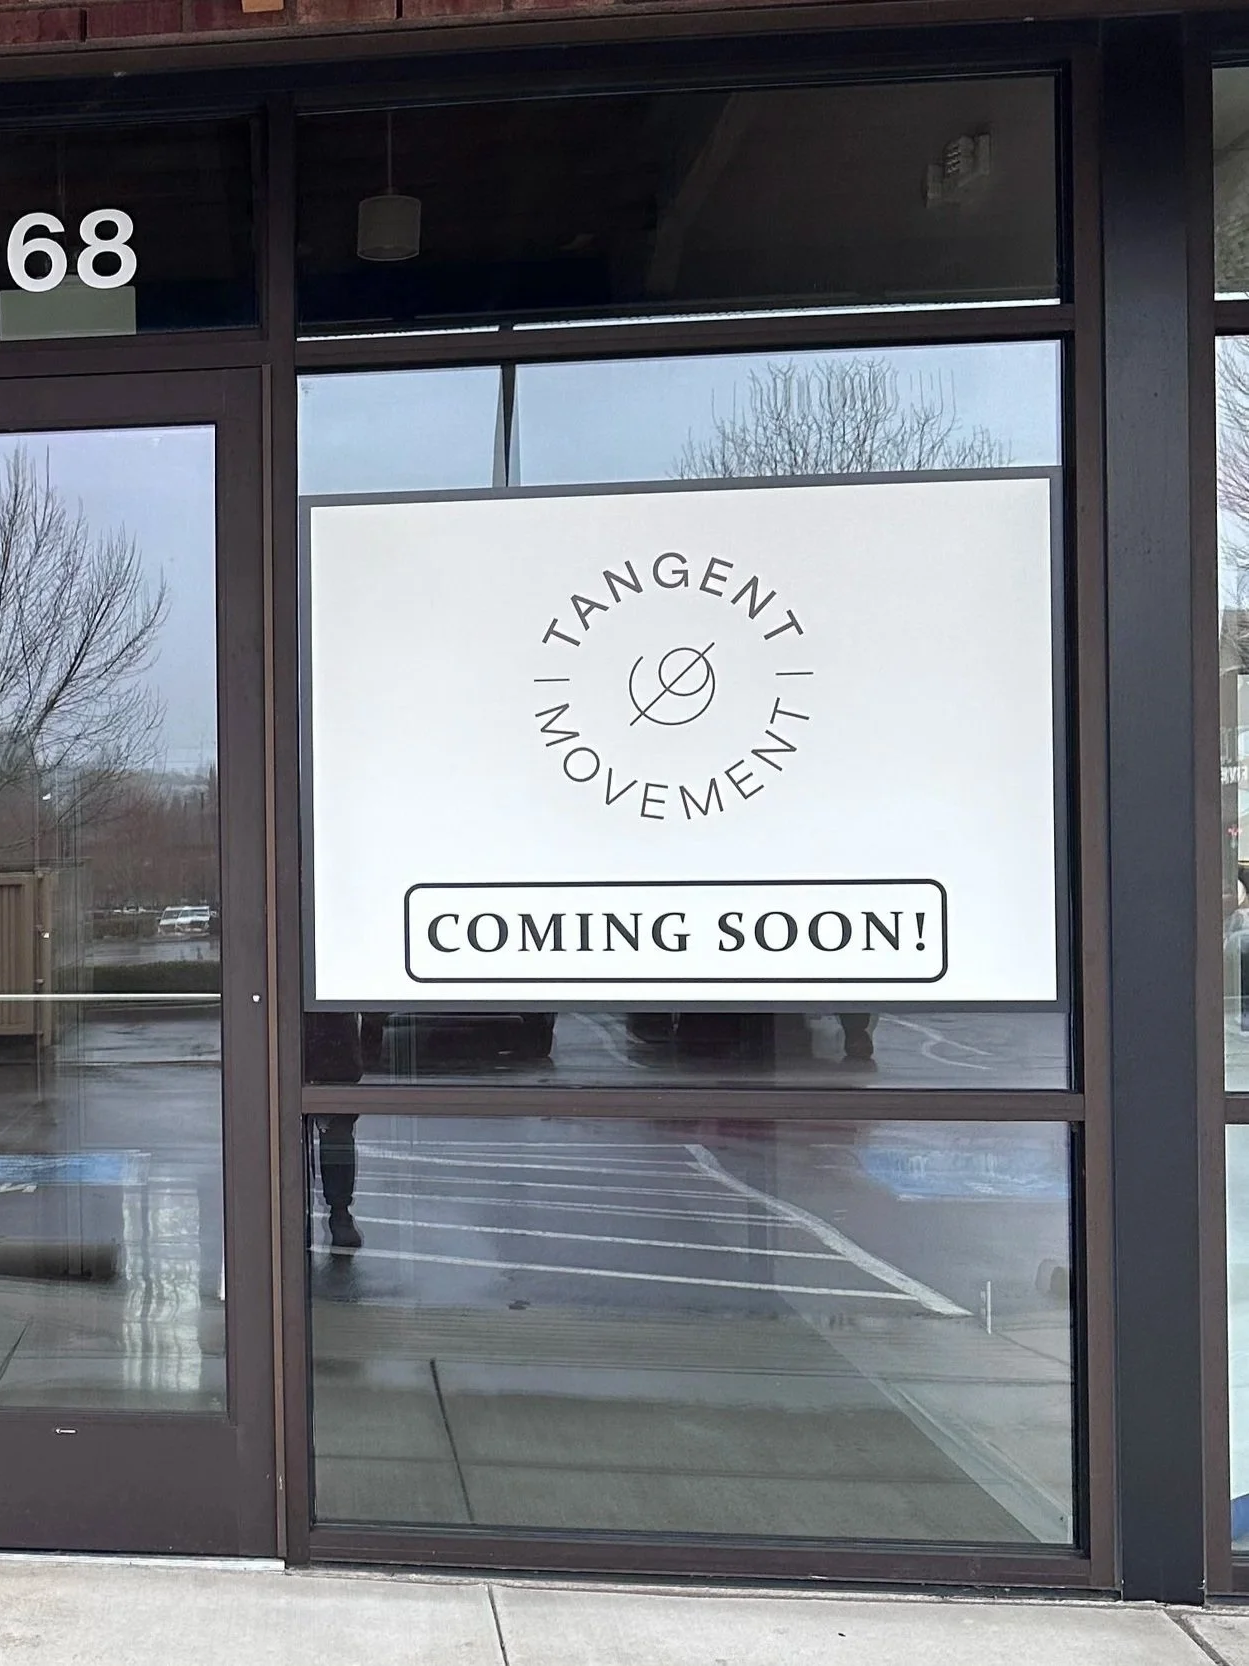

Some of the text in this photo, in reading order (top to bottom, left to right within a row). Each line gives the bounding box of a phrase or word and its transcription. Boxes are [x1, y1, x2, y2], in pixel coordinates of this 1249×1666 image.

[541, 552, 804, 647] TANGENT
[534, 697, 810, 820] MOVEMENT
[427, 910, 926, 953] COMING SOON!
